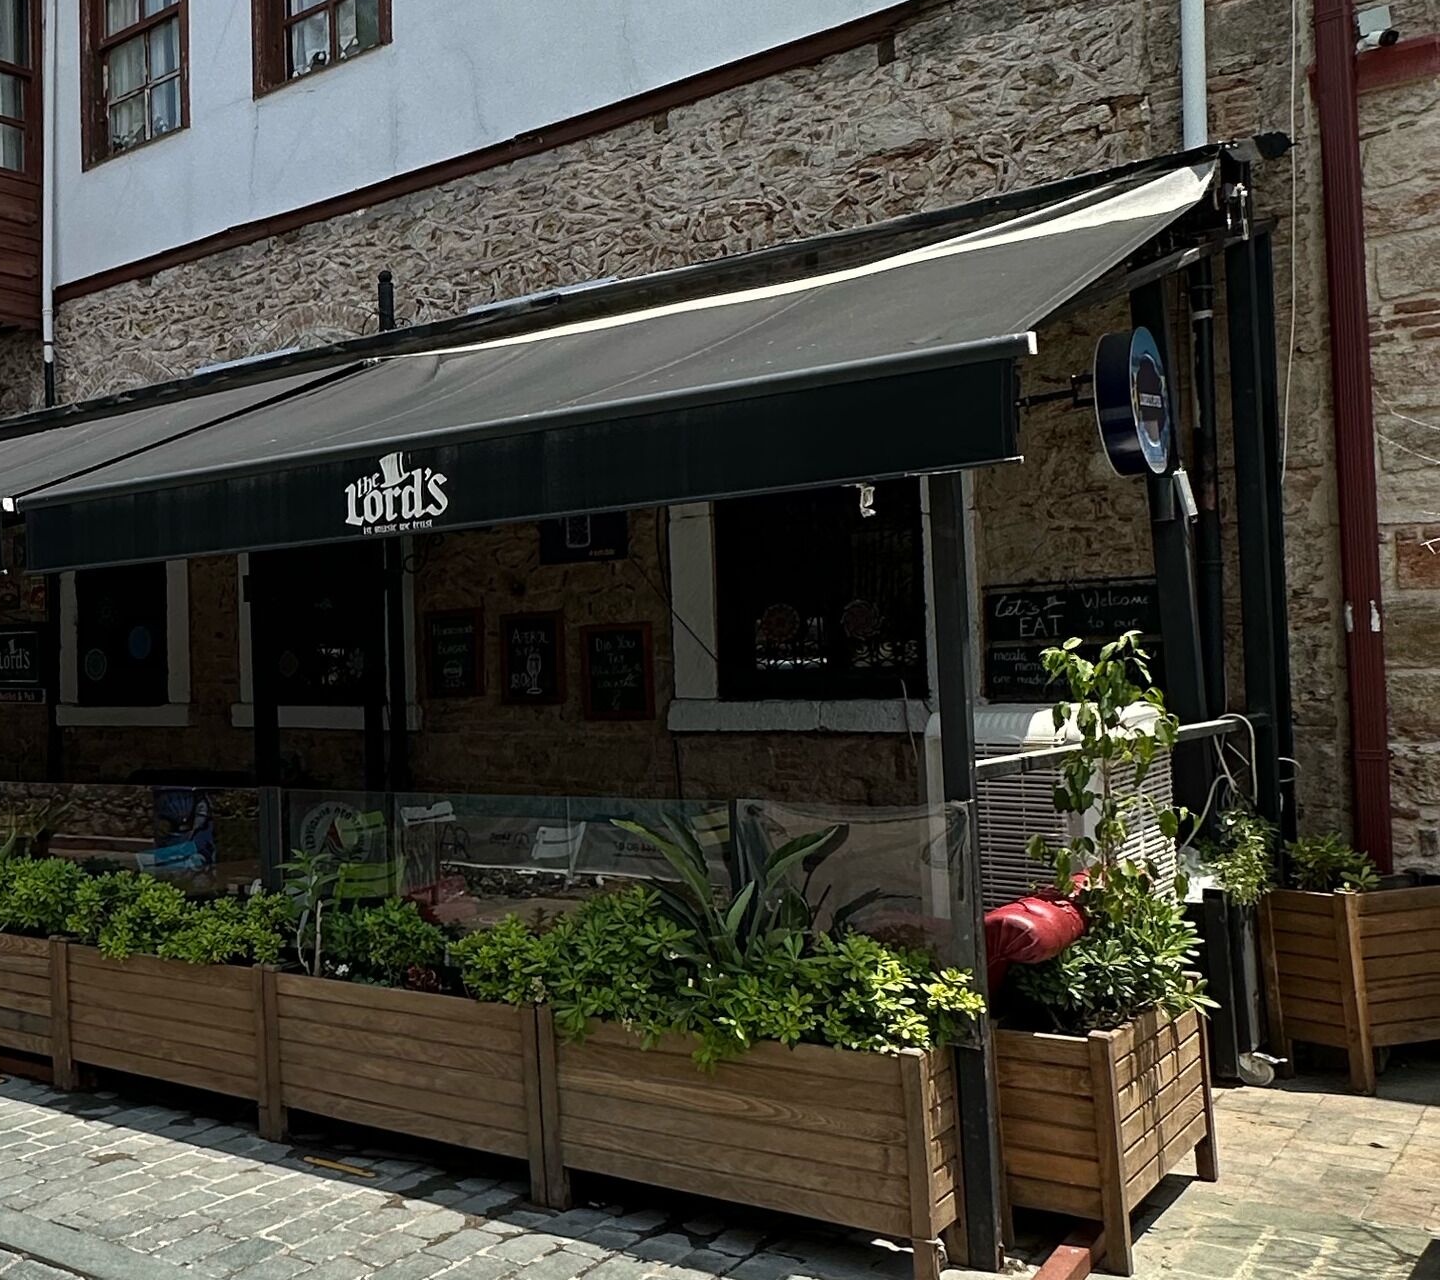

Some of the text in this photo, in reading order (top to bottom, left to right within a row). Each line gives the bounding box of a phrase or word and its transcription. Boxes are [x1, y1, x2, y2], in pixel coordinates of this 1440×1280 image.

[345, 468, 448, 526] Lord's
[357, 473, 380, 498] the
[413, 519, 433, 529] trust
[994, 595, 1040, 618] Let's
[1080, 589, 1151, 609] Welcome
[1019, 615, 1065, 638] EAT
[1088, 616, 1104, 628] to
